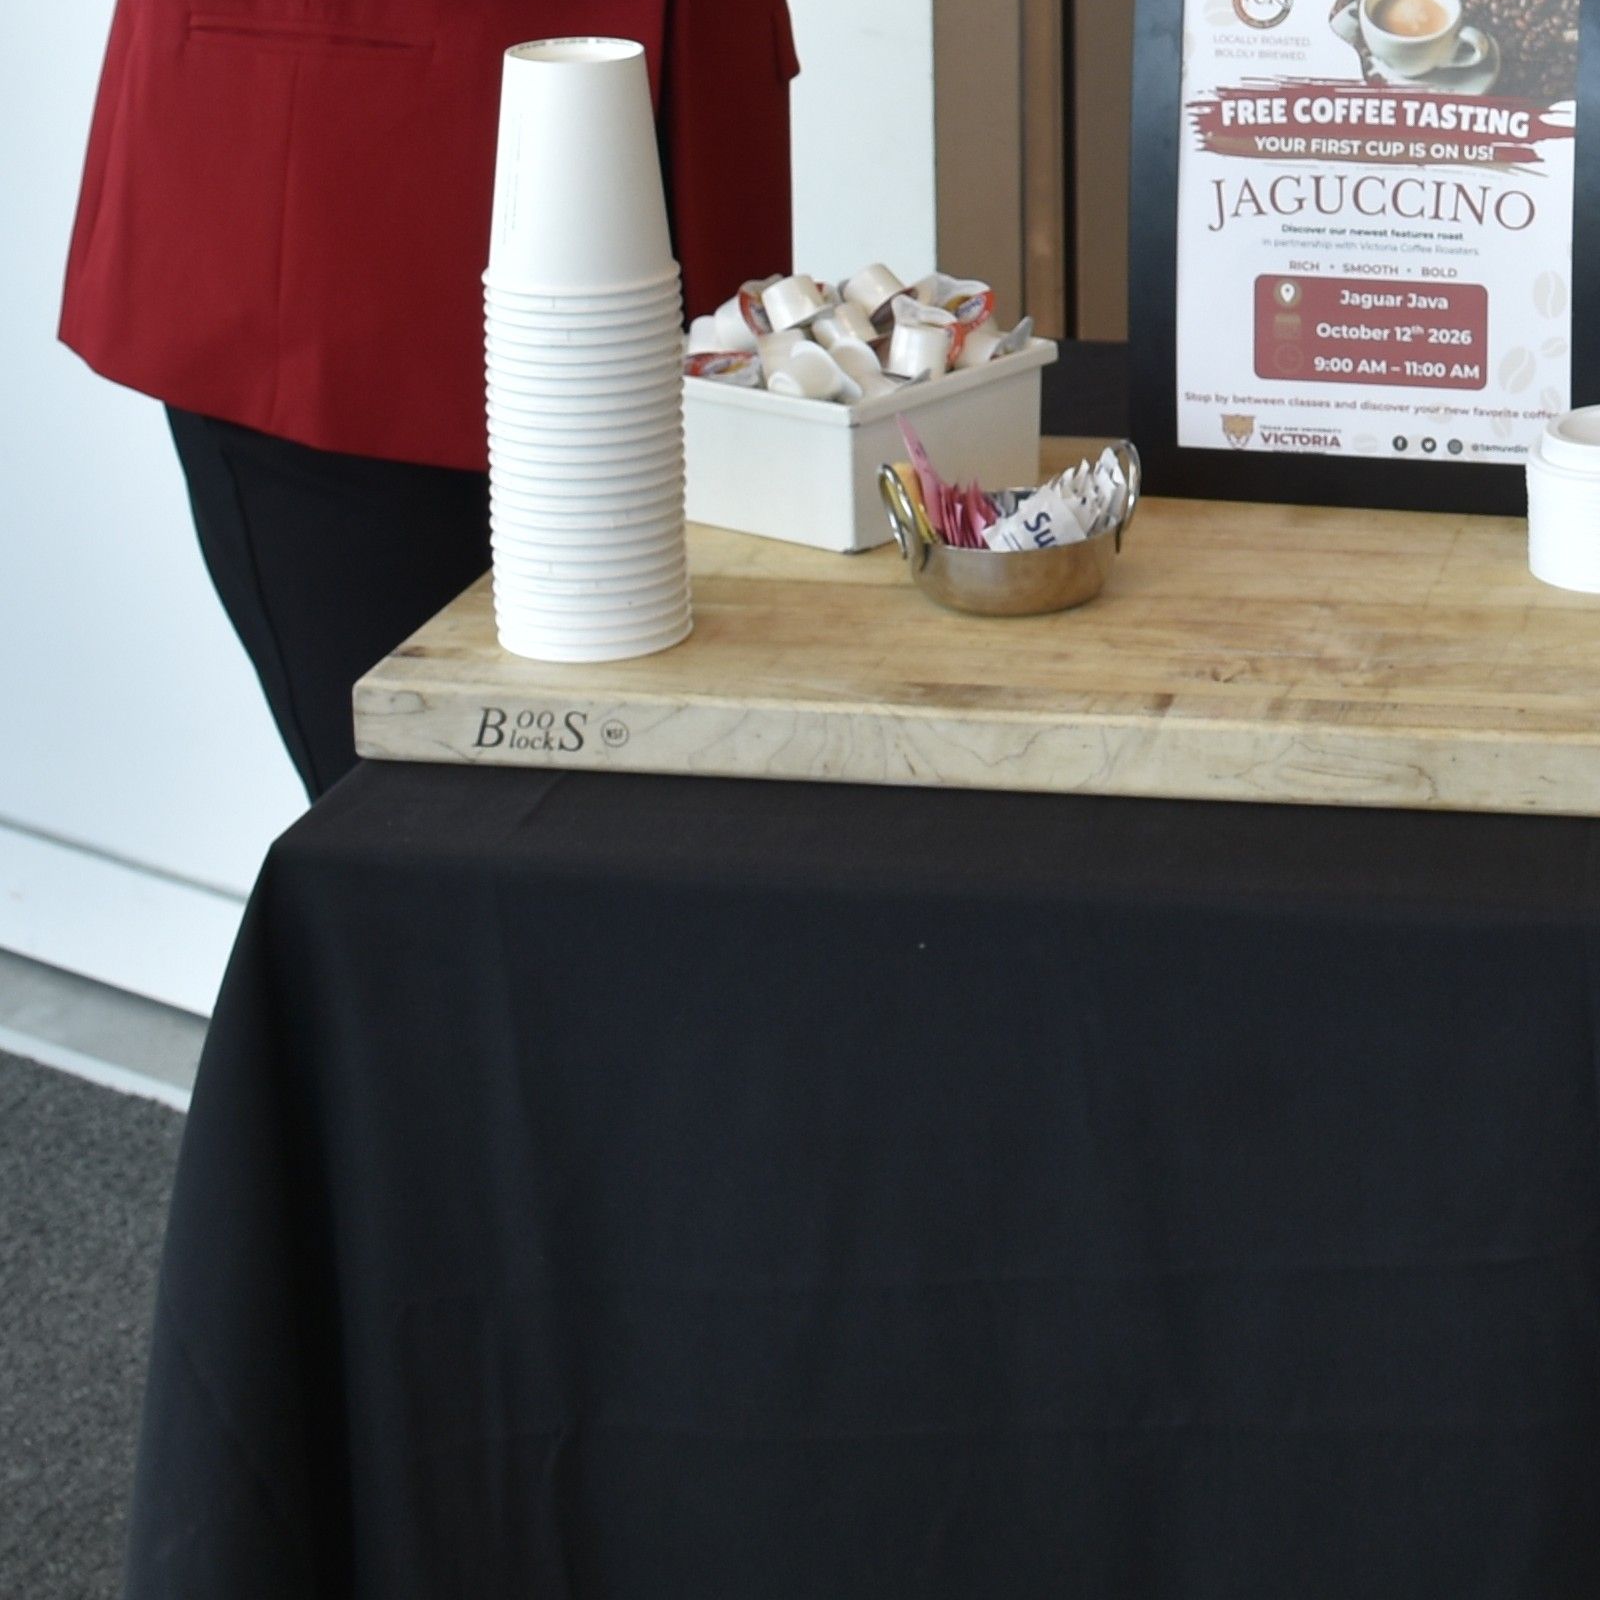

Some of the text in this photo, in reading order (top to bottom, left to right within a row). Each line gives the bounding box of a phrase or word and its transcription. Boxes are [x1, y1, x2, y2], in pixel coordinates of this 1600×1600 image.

[1220, 97, 1530, 138] FREE COFFEE TASTING
[1254, 136, 1495, 161] YOUR FIRST CUP IS ON US!
[1208, 175, 1536, 232] JAGUCCINO
[1281, 223, 1327, 234] Discover
[1329, 227, 1347, 236] our
[1350, 227, 1389, 238] newest
[1437, 232, 1464, 241] roast
[1274, 239, 1332, 251] partnership
[1335, 240, 1357, 250] with
[1360, 241, 1398, 252] Victoria
[1400, 243, 1432, 254] Coffee
[1289, 260, 1458, 279] RICH SMOOTH BOLD
[1340, 289, 1449, 311] Jaguar Java
[1316, 322, 1473, 345] October 12th 2026
[1313, 356, 1353, 374] 9:00
[1357, 358, 1387, 375] AM
[1403, 360, 1446, 377] 11:00
[1450, 363, 1480, 380] AM
[1184, 392, 1212, 403] Stop
[1215, 392, 1229, 405] by
[1232, 394, 1285, 406] between
[1287, 397, 1331, 409] classes
[1334, 399, 1357, 410] and
[1360, 401, 1410, 413] discover
[1413, 404, 1440, 415] your
[1444, 406, 1469, 416] new
[1473, 407, 1519, 419] favorite
[1260, 431, 1342, 448] VICTORIA
